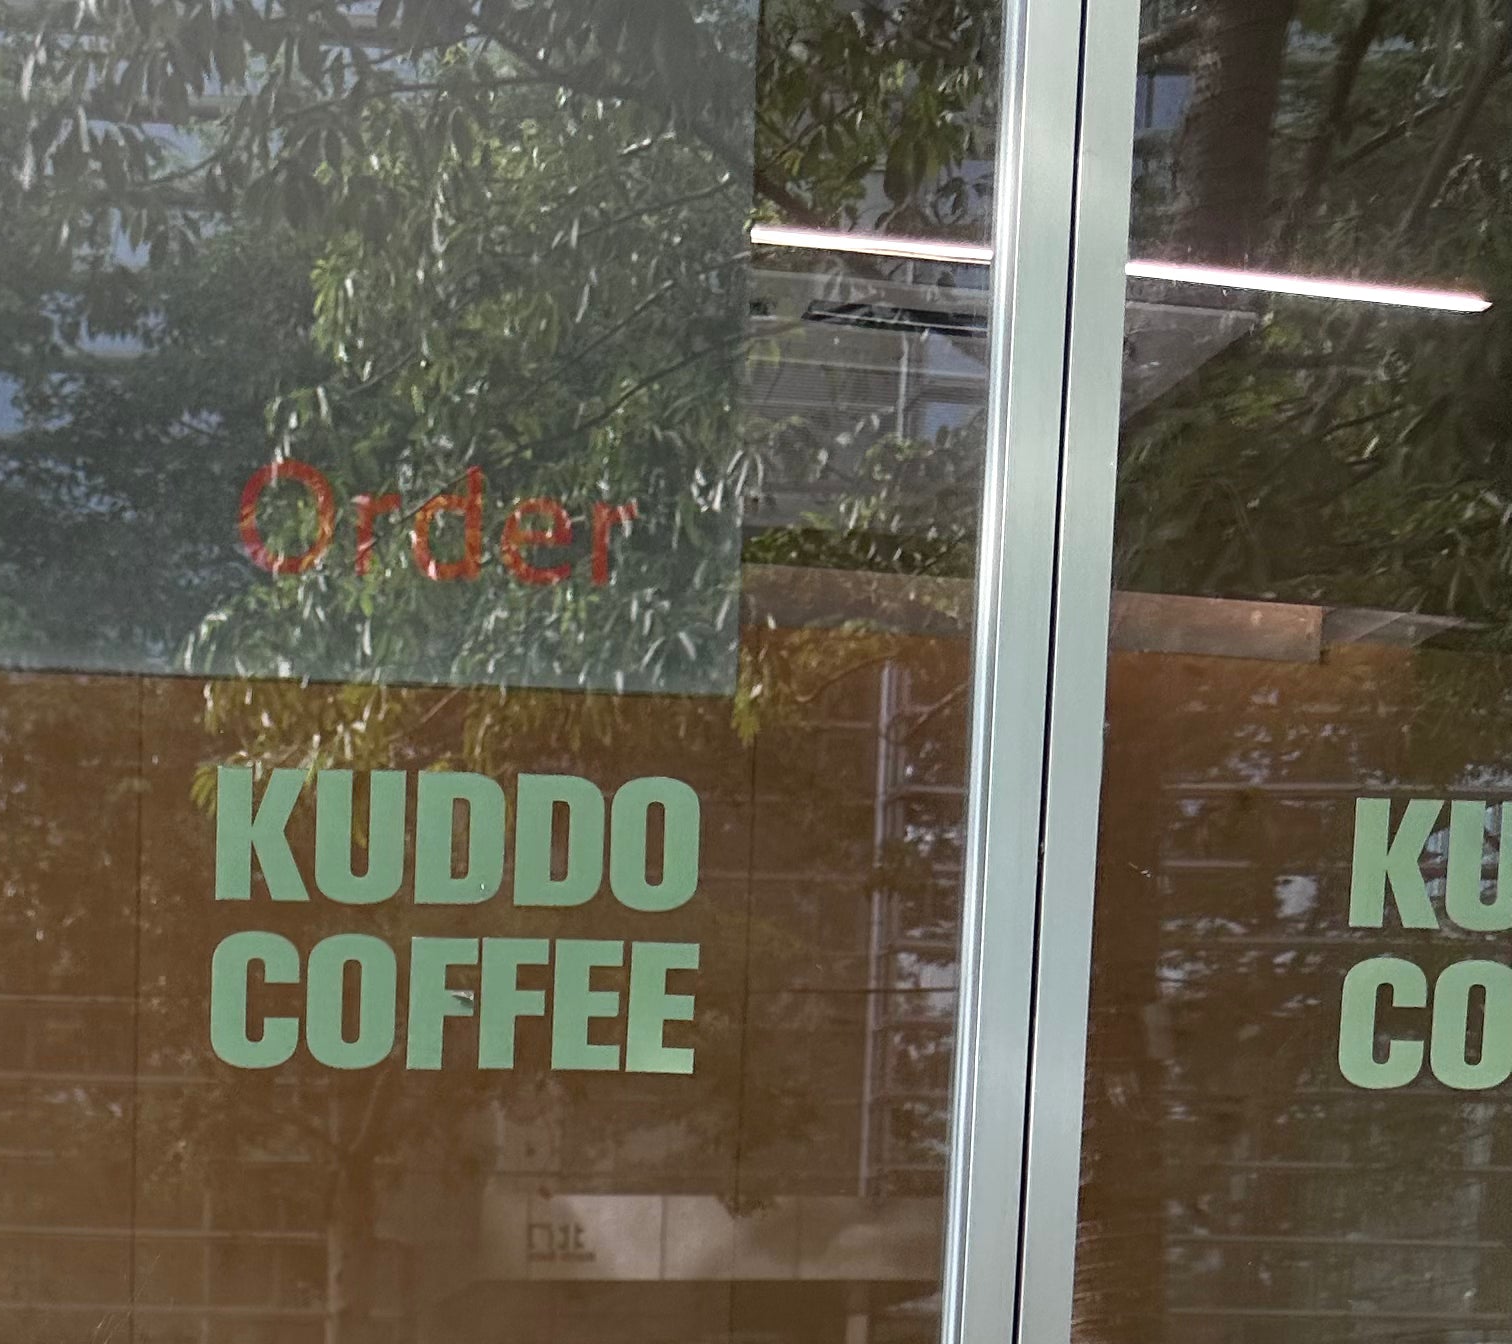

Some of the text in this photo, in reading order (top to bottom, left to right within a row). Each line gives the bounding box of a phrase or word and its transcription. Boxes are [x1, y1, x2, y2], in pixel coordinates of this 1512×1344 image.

[239, 459, 639, 586] Order
[215, 766, 701, 912] KUDDO
[1349, 797, 1512, 932] KU
[210, 931, 701, 1074] COFFEE
[1338, 957, 1512, 1090] CO
